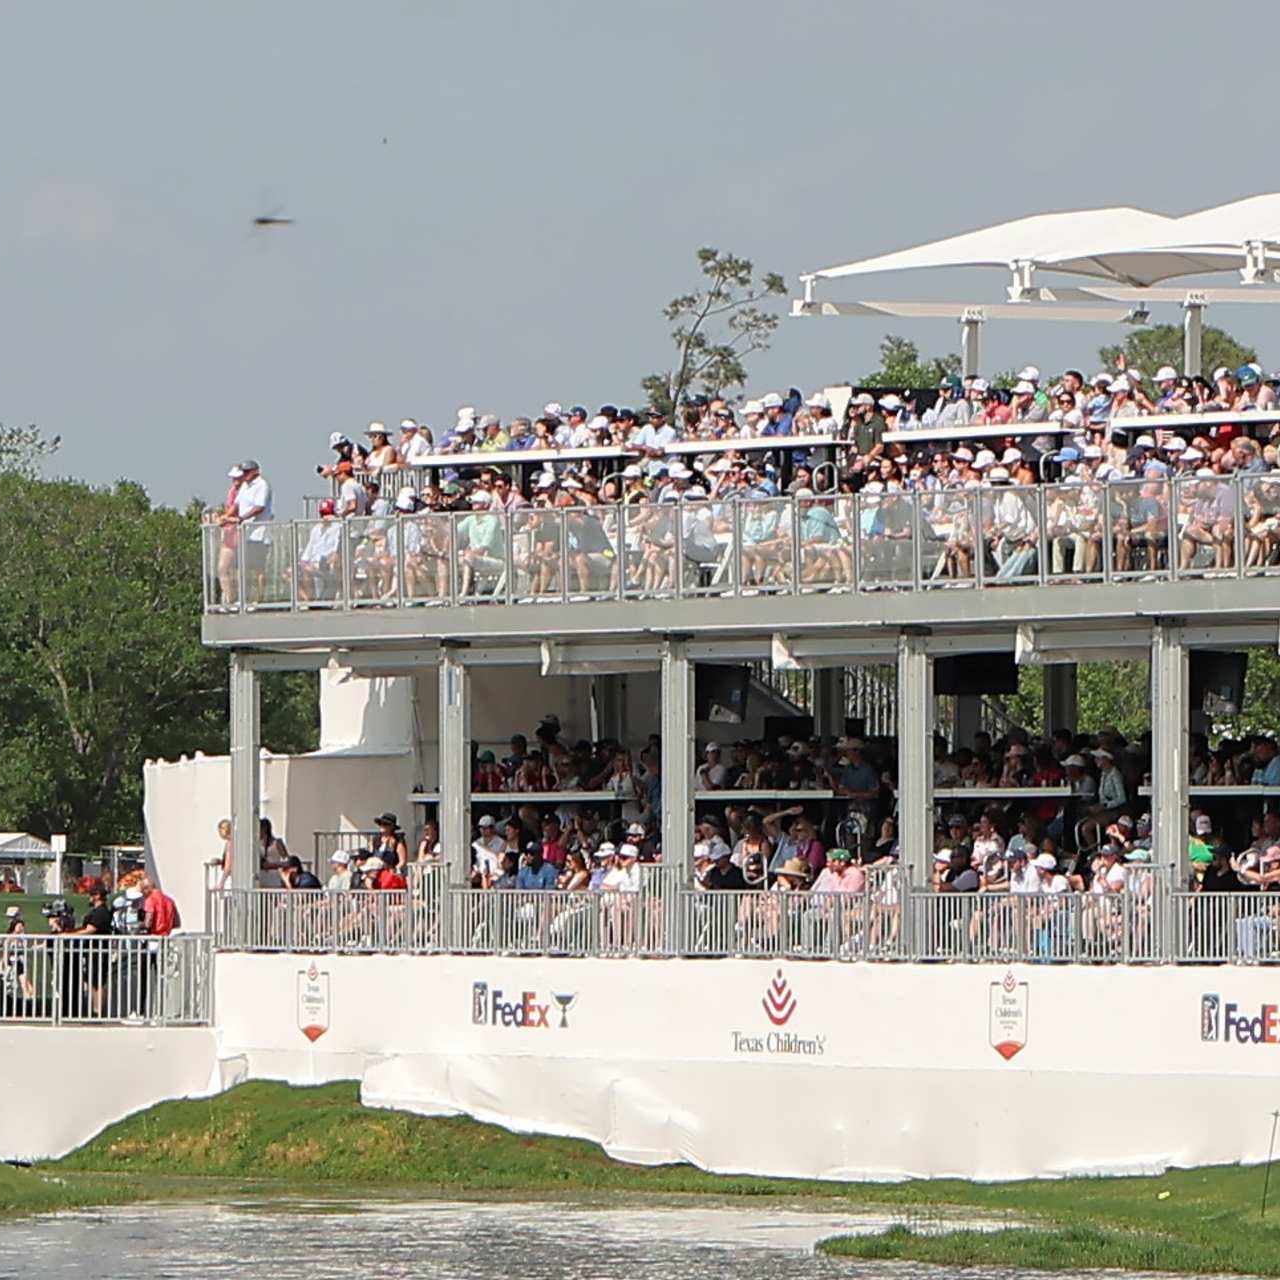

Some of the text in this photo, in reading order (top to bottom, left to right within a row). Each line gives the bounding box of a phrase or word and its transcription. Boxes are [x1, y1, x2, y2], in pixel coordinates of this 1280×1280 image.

[492, 989, 550, 1028] FedEx
[731, 1030, 825, 1056] Texas Children's
